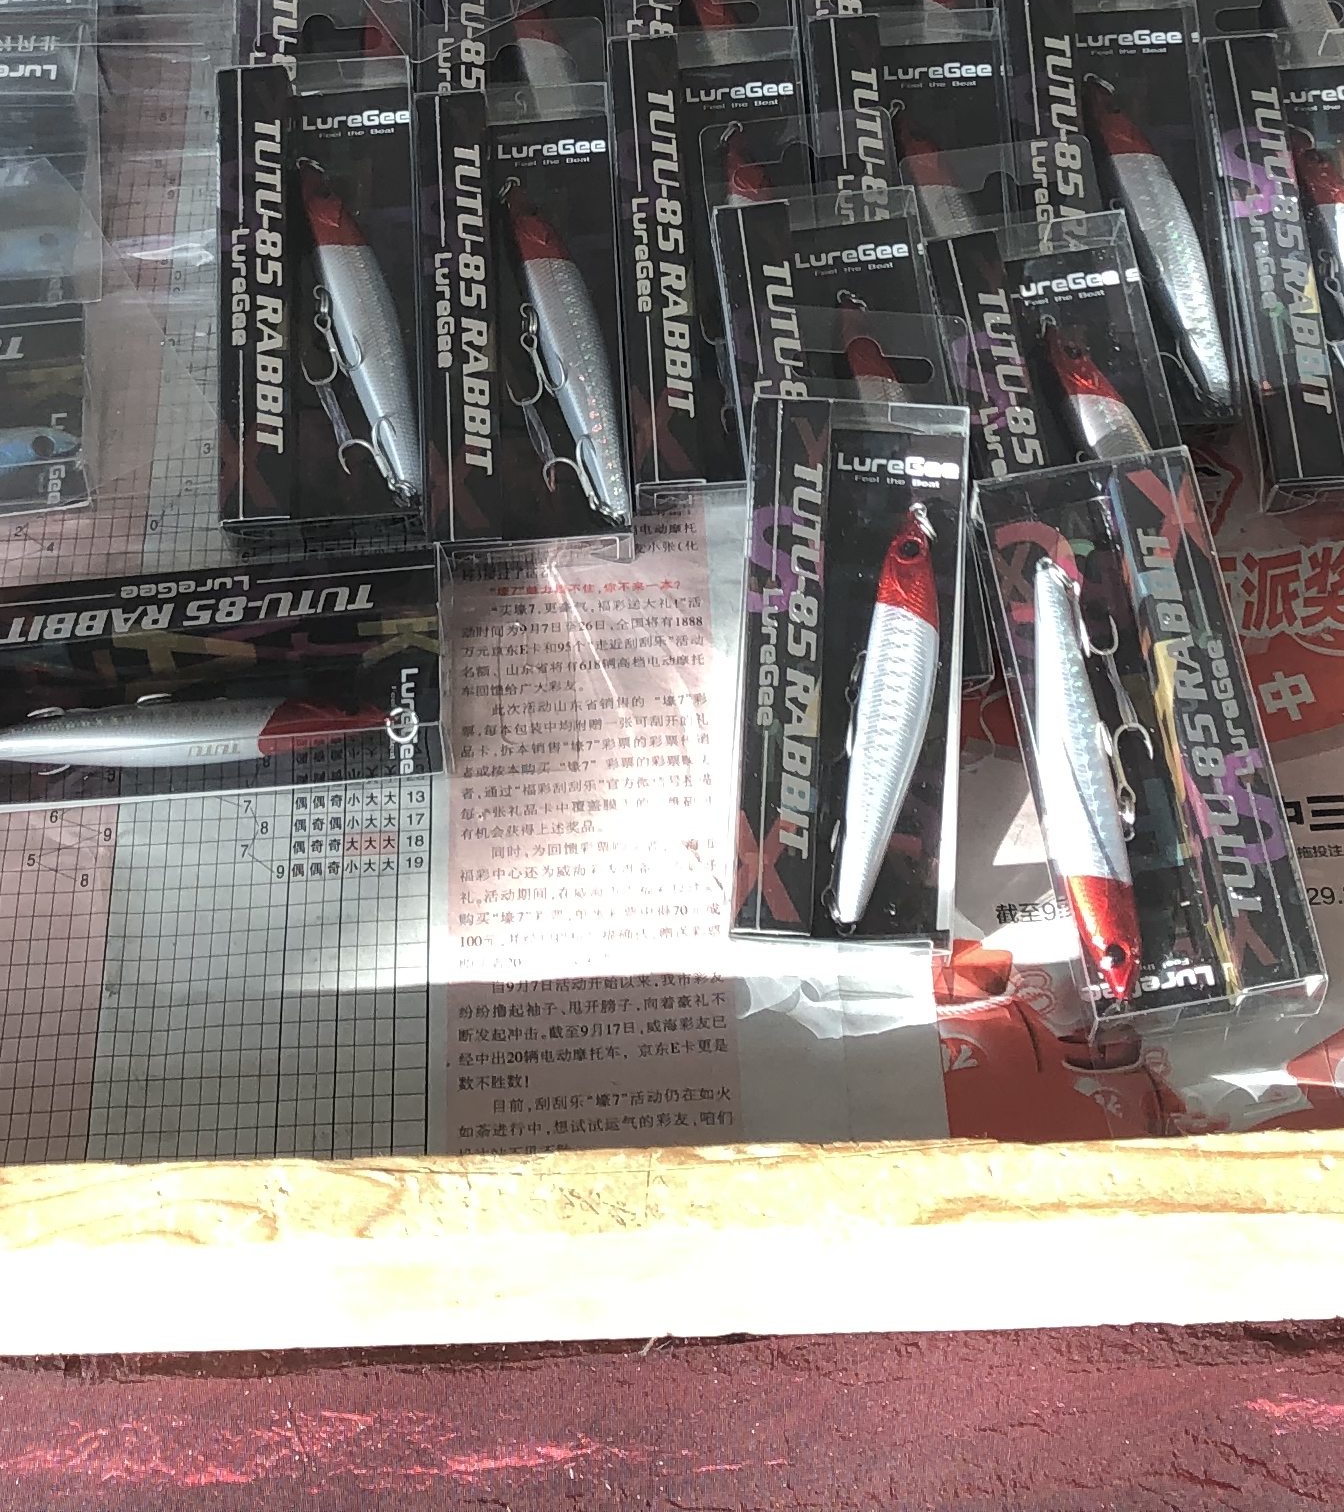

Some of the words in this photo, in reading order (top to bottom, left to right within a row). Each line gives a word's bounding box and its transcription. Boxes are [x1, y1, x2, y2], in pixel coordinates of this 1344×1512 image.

[686, 81, 794, 103] LureGee
[883, 62, 992, 81] LureGee
[1076, 29, 1183, 48] LureGee
[302, 110, 410, 130] LureGee
[497, 138, 606, 160] LureGee
[648, 90, 685, 254] TUTU-85
[1044, 34, 1085, 199] TUTU-85
[254, 119, 284, 286] TUTU-85
[454, 145, 488, 311] TUTU-85
[631, 196, 652, 313] LureGee
[795, 243, 909, 269] LureGee
[1251, 86, 1303, 260] TUTU-85
[1281, 255, 1332, 415] RABBIT
[231, 228, 251, 347] LureGee
[433, 252, 454, 369] LureGee
[658, 259, 696, 419] RABBIT
[254, 292, 284, 454] RABBIT
[461, 315, 493, 476] RABBIT
[977, 289, 1045, 466] TUTU-85
[837, 453, 960, 479] LureGee
[121, 575, 250, 599] LureGee
[184, 584, 375, 628] TUTU-85
[787, 463, 823, 662] TUTU-85
[1137, 526, 1208, 702] RABBIT
[0, 603, 175, 645] RABBIT
[757, 587, 783, 726] LureGee
[1258, 670, 1315, 722] 中
[406, 813, 425, 826] 17
[407, 791, 425, 804] 13
[779, 667, 815, 859] RABBIT
[1182, 709, 1263, 918] TUTU-85
[406, 835, 424, 847] 18
[406, 857, 424, 869] 19
